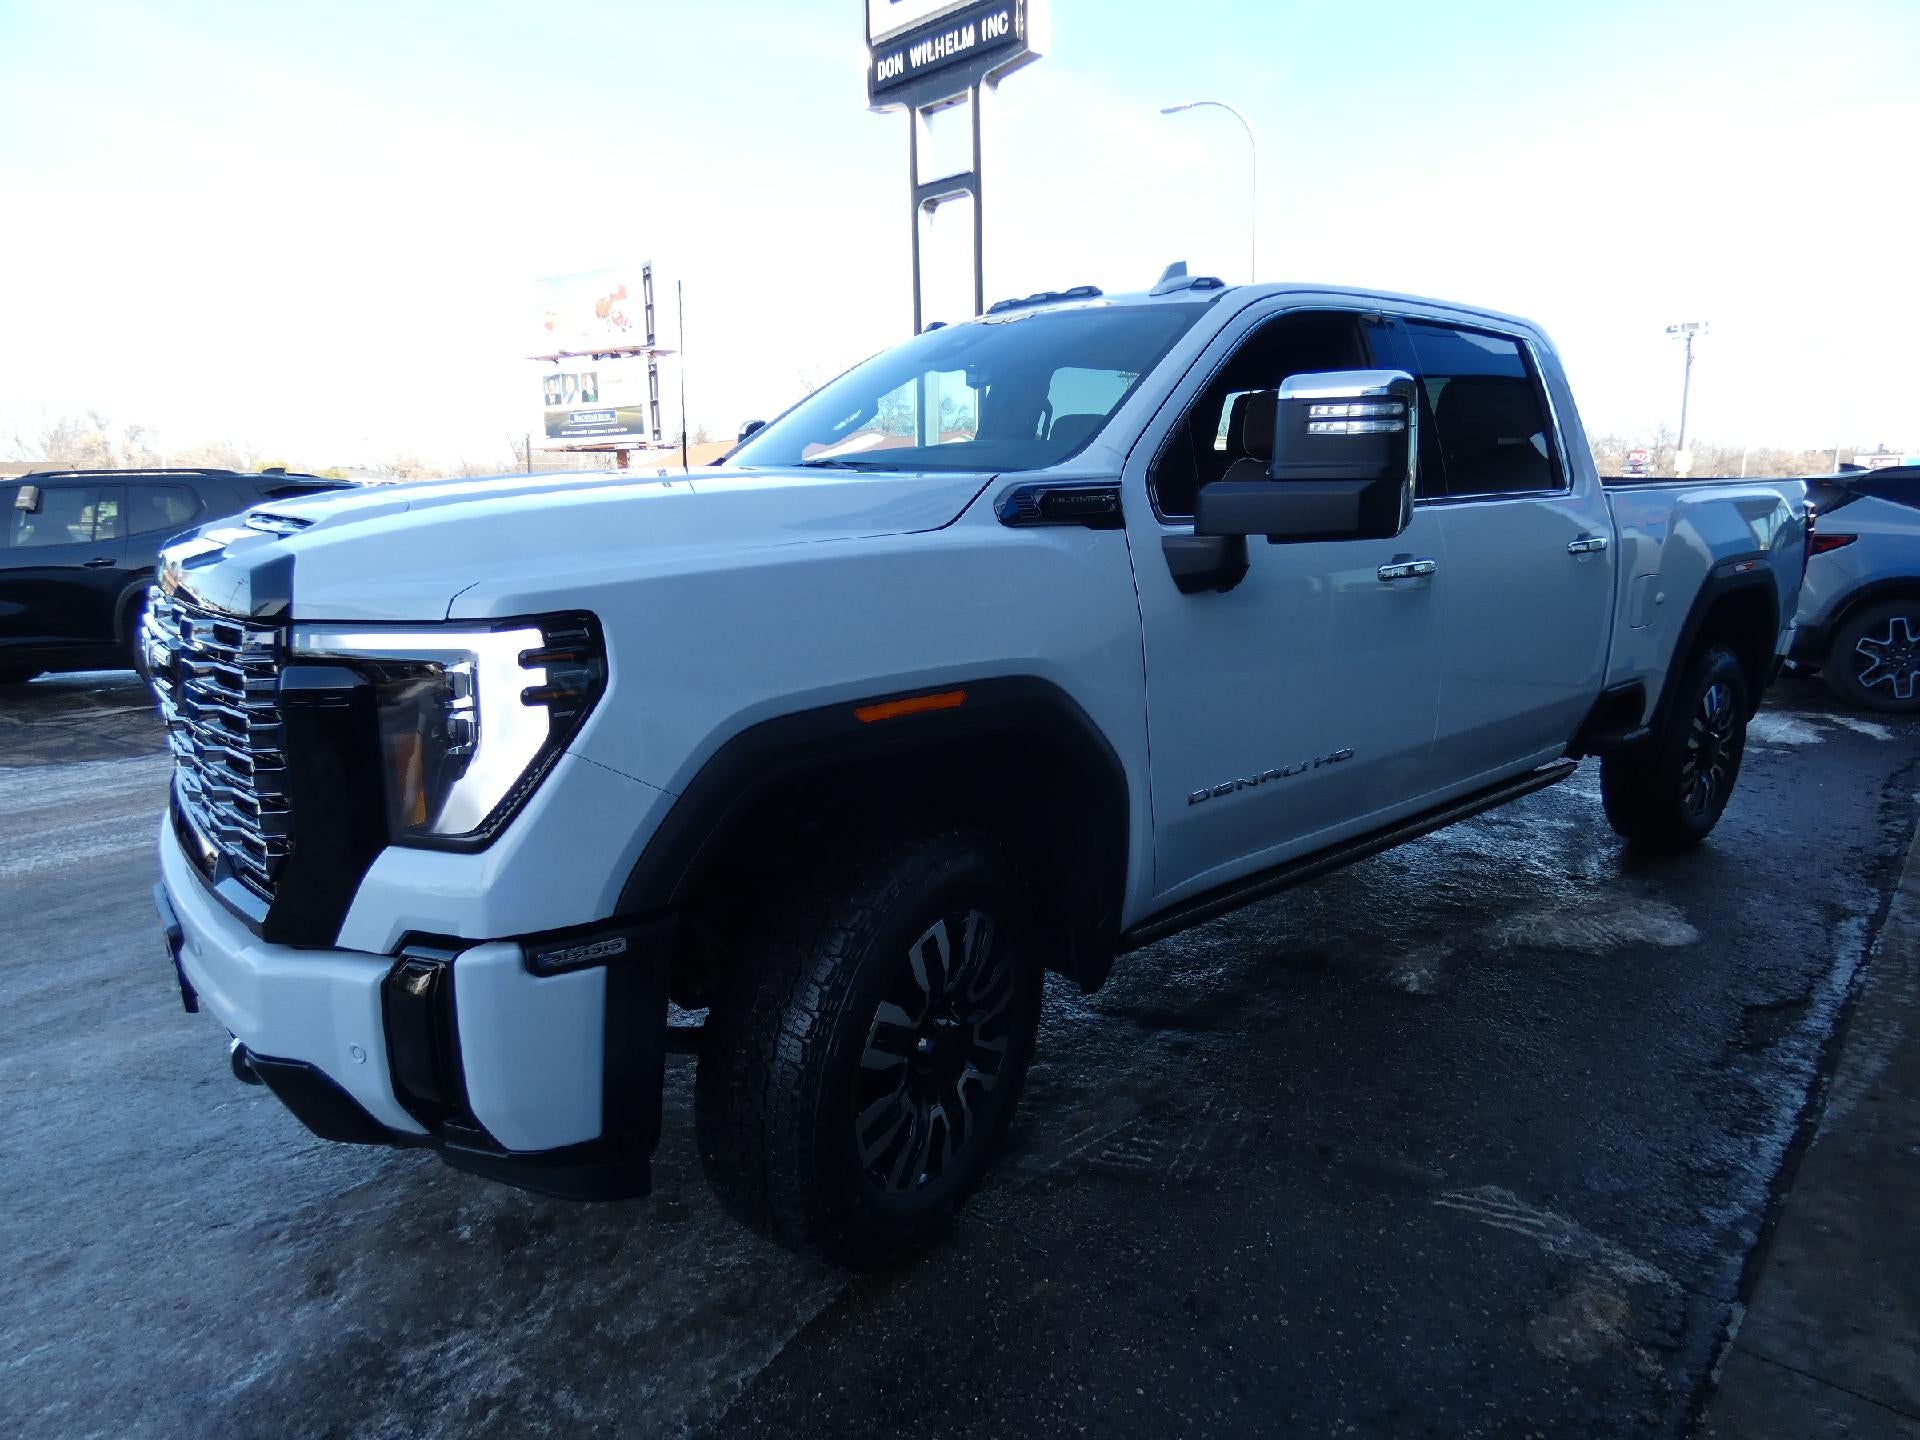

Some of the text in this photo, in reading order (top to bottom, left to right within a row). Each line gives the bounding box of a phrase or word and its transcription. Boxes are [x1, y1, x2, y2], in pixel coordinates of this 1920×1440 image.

[877, 11, 1009, 82] DON WILHELM INC
[1187, 748, 1354, 807] DENALI HD
